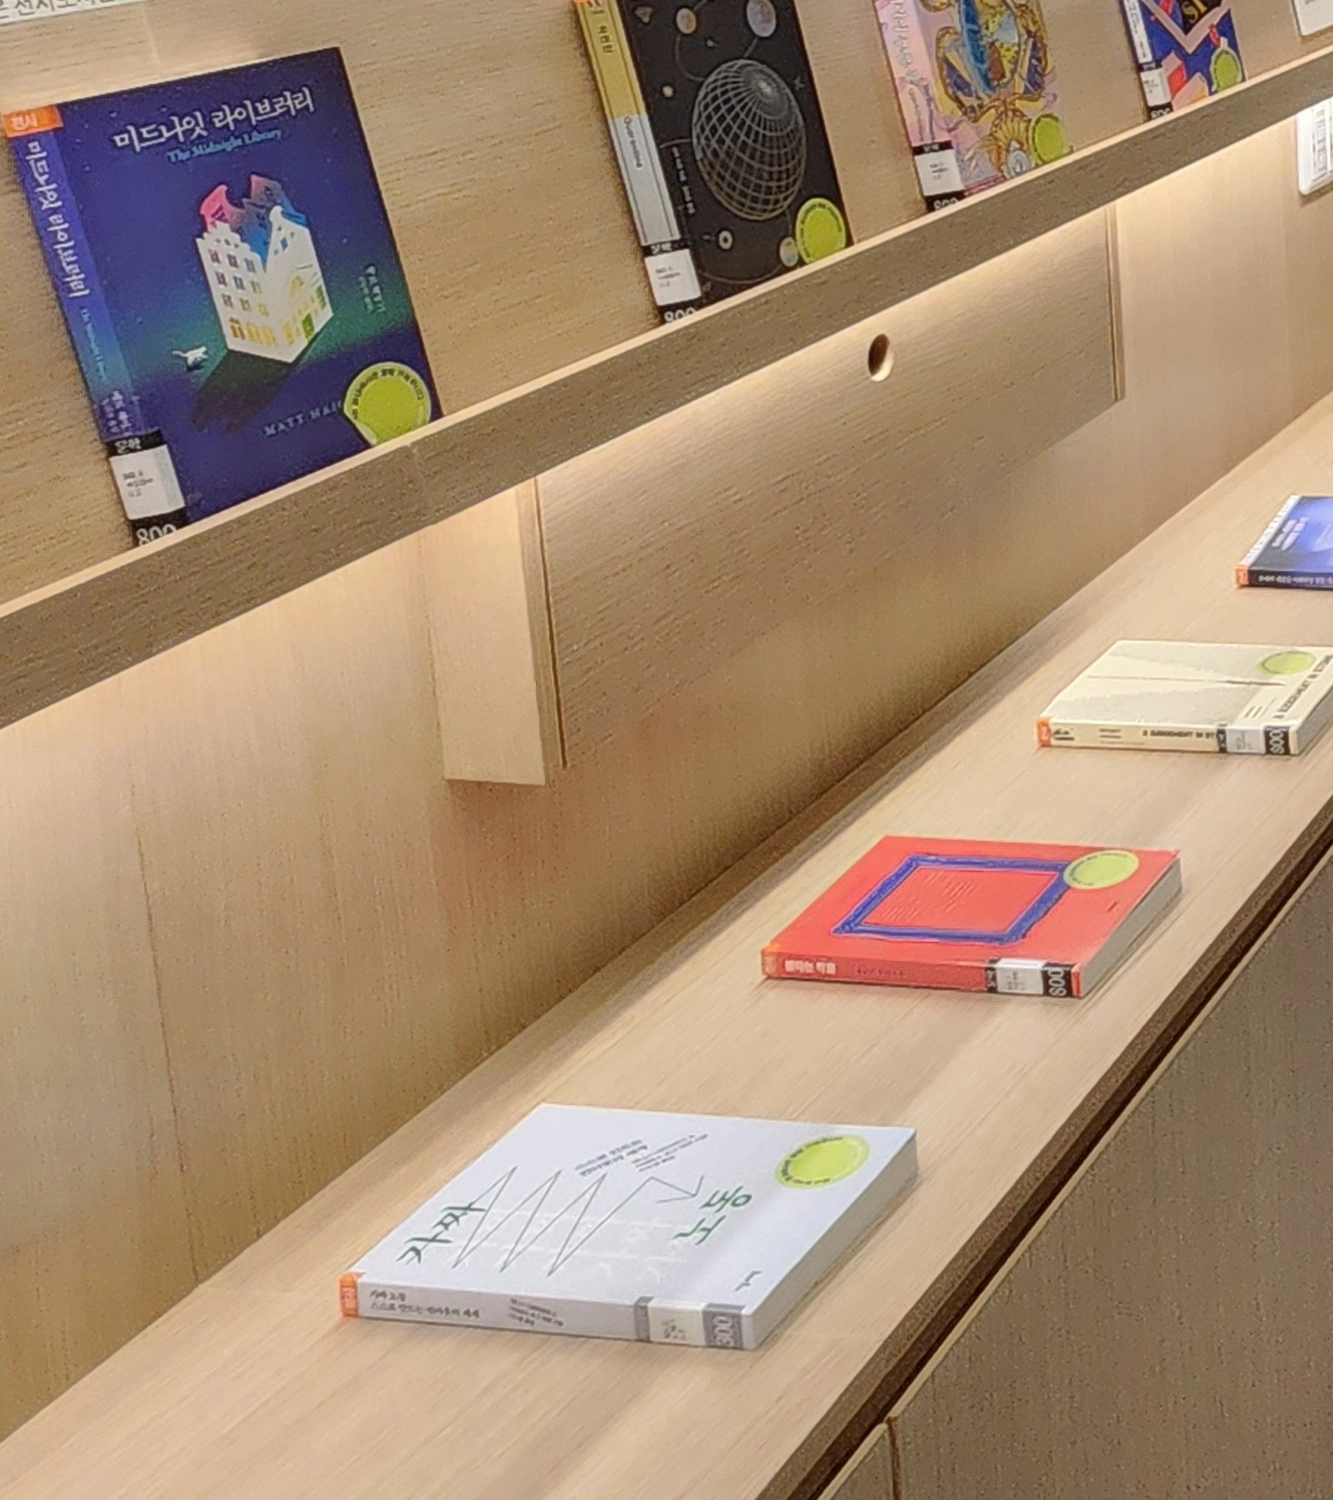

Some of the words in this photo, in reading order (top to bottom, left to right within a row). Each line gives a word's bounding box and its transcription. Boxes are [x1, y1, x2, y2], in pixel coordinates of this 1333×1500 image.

[111, 114, 209, 152] 미드나잇
[211, 87, 315, 130] 라이브러리
[166, 147, 191, 164] The
[26, 140, 63, 210] 미드나잇
[48, 213, 91, 298] 라이브러리
[263, 415, 304, 438] MATT
[397, 1201, 487, 1264] 가짜
[673, 1185, 752, 1246] 노동
